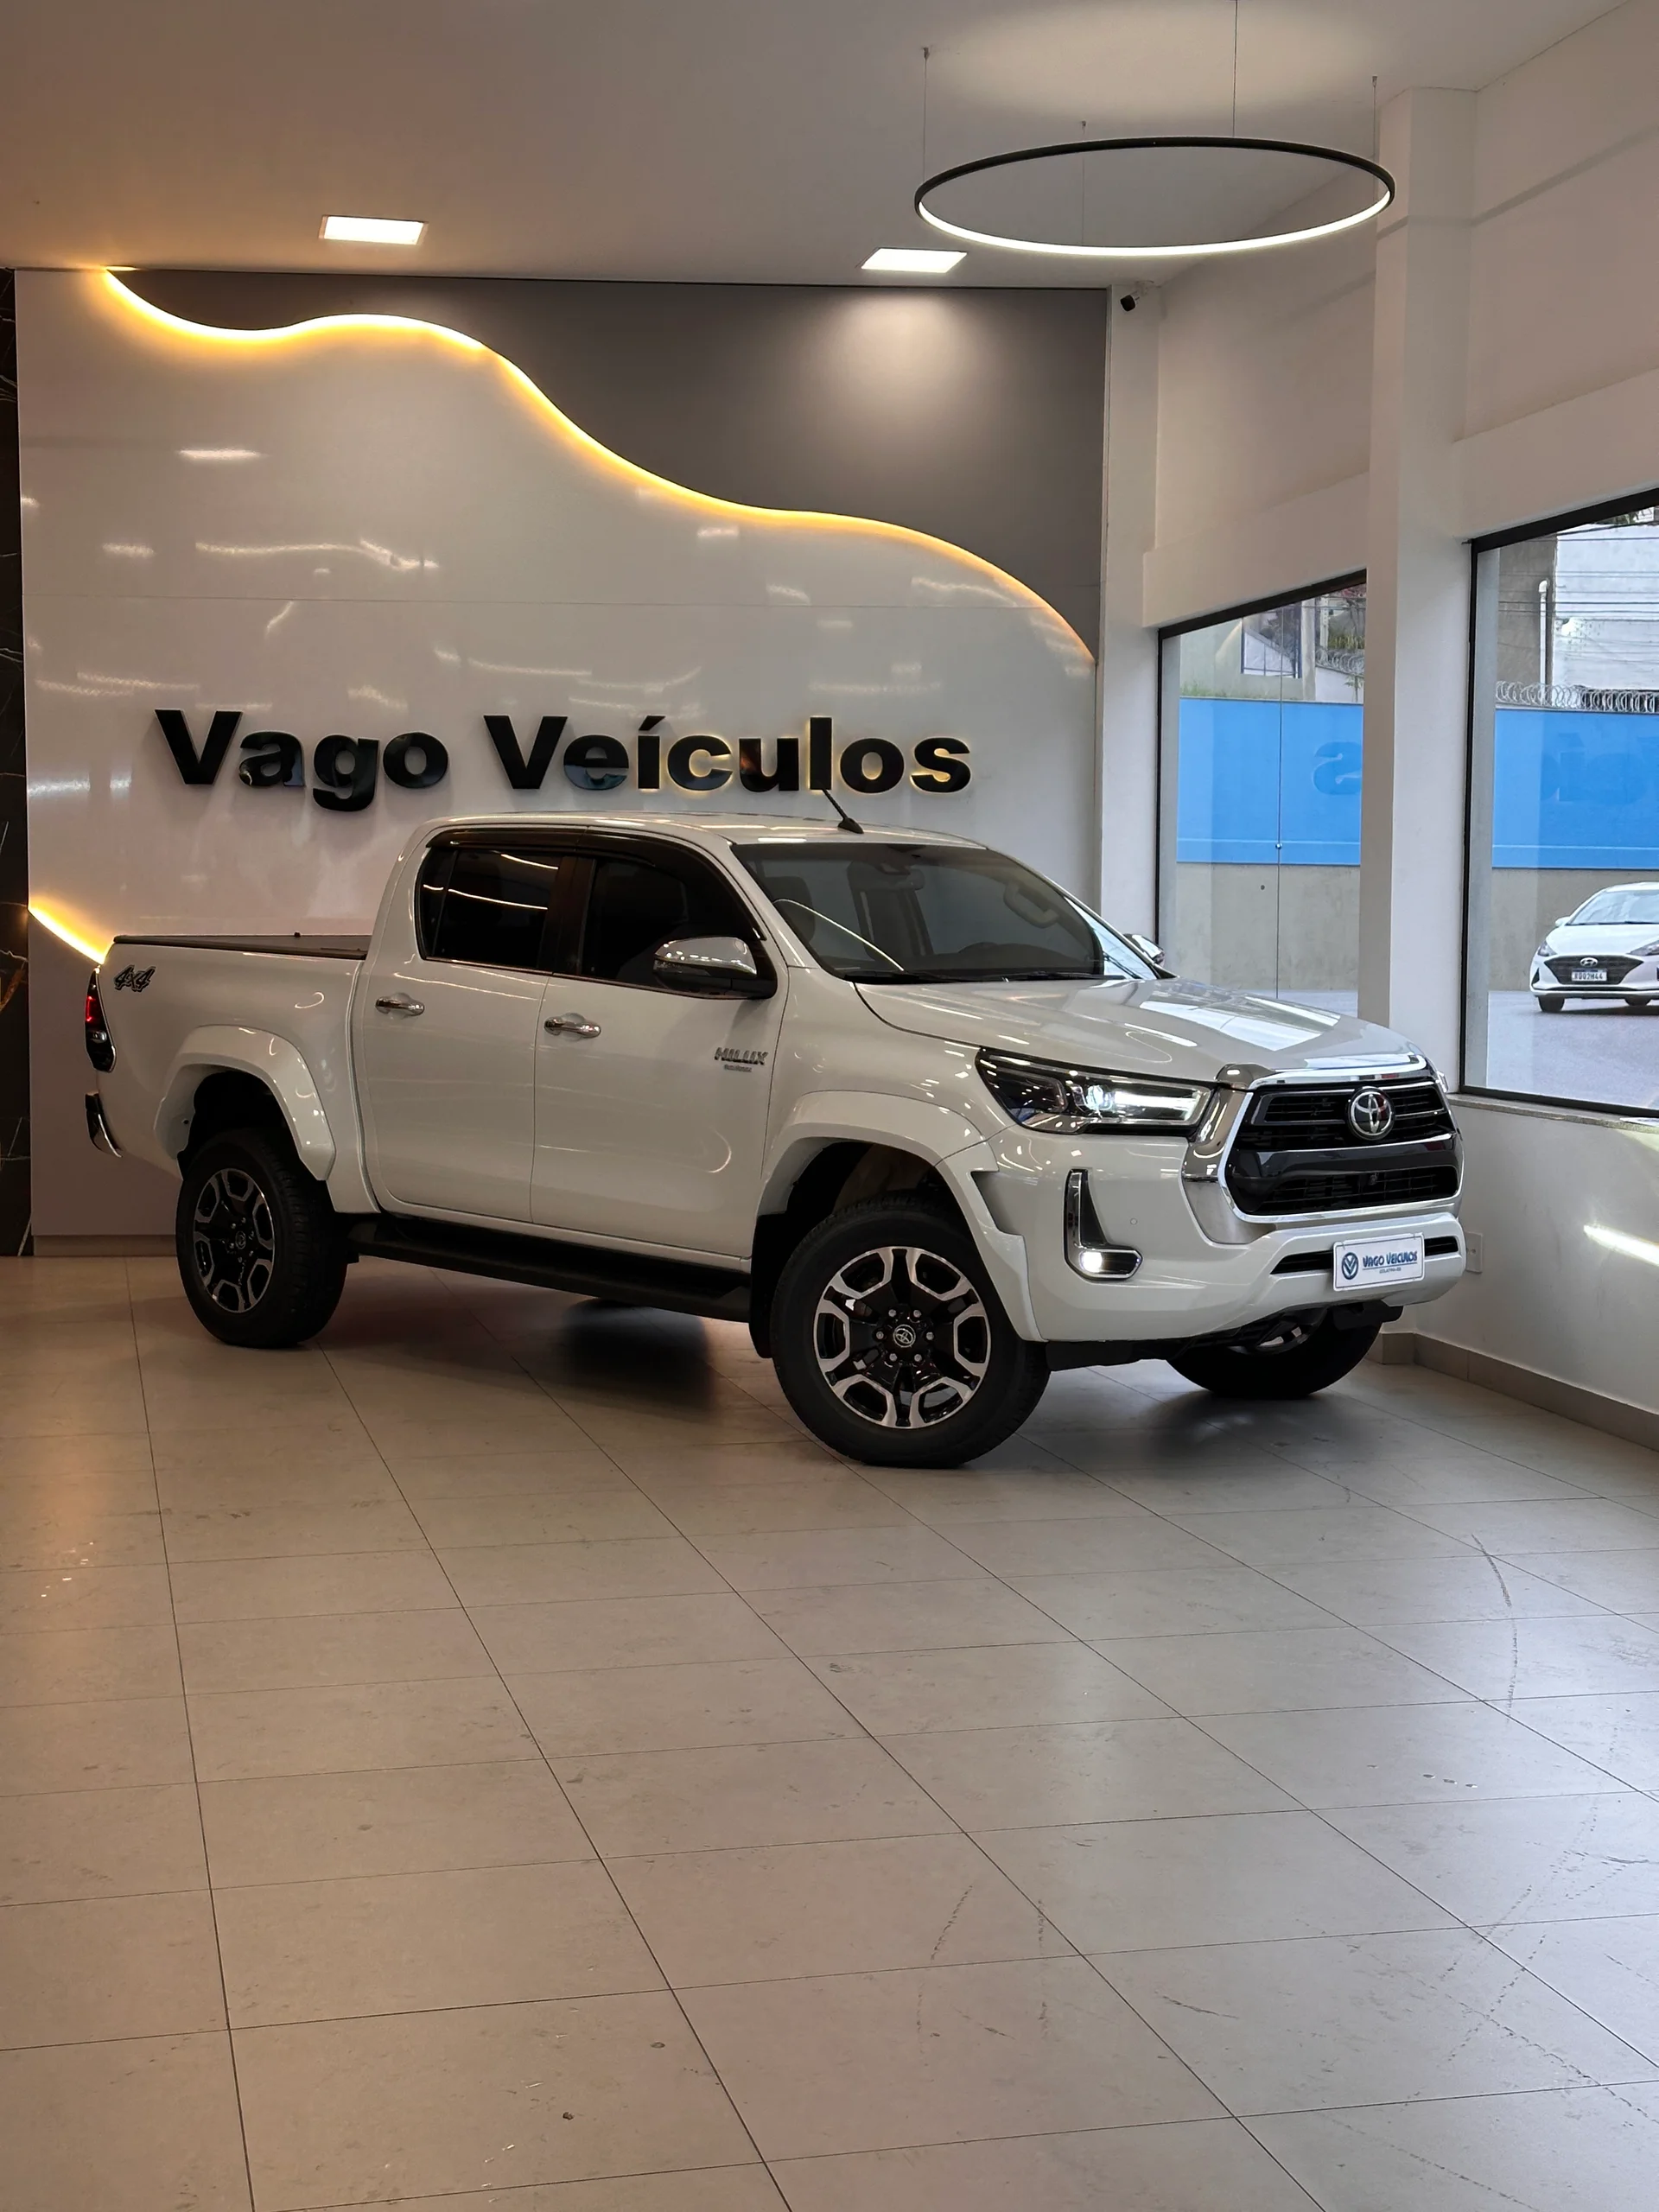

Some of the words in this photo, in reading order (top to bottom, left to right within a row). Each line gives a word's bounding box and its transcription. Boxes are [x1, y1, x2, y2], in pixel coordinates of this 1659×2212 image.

[155, 709, 448, 811] Vago
[484, 715, 971, 793] Veículos
[714, 1046, 768, 1065] HILUX
[1363, 1255, 1385, 1268] VAGO
